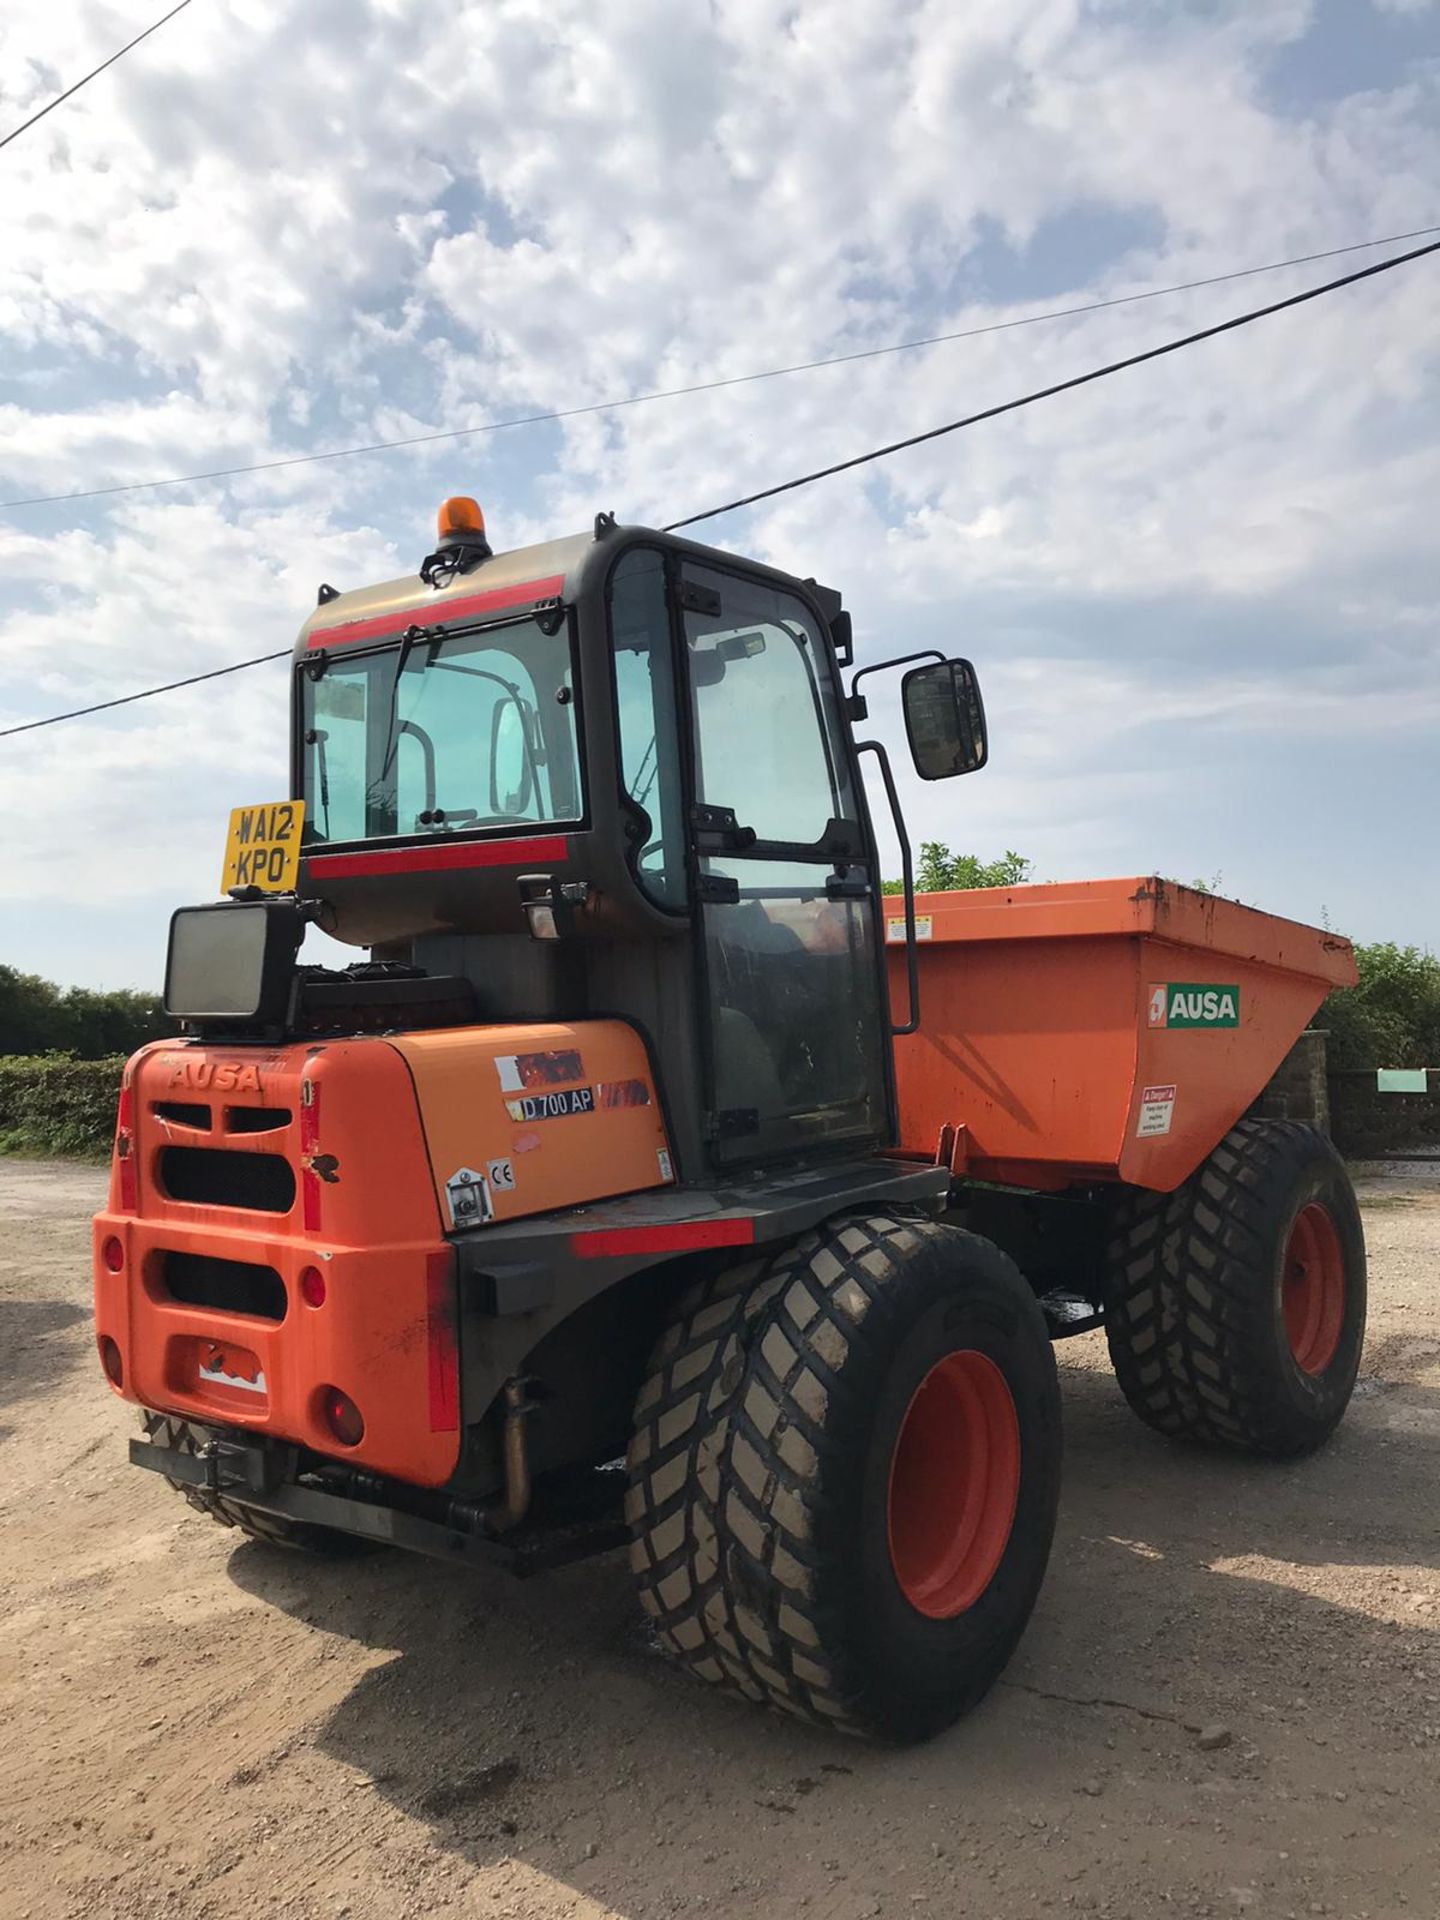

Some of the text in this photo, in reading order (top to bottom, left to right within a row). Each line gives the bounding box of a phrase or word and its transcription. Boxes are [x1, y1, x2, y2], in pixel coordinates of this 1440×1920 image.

[240, 805, 294, 843] WA12
[236, 847, 285, 884] KPO
[1169, 991, 1236, 1020] AUSA
[169, 1062, 263, 1091] AUSA
[523, 1090, 591, 1120] D 700 AP
[492, 1164, 512, 1184] CE
